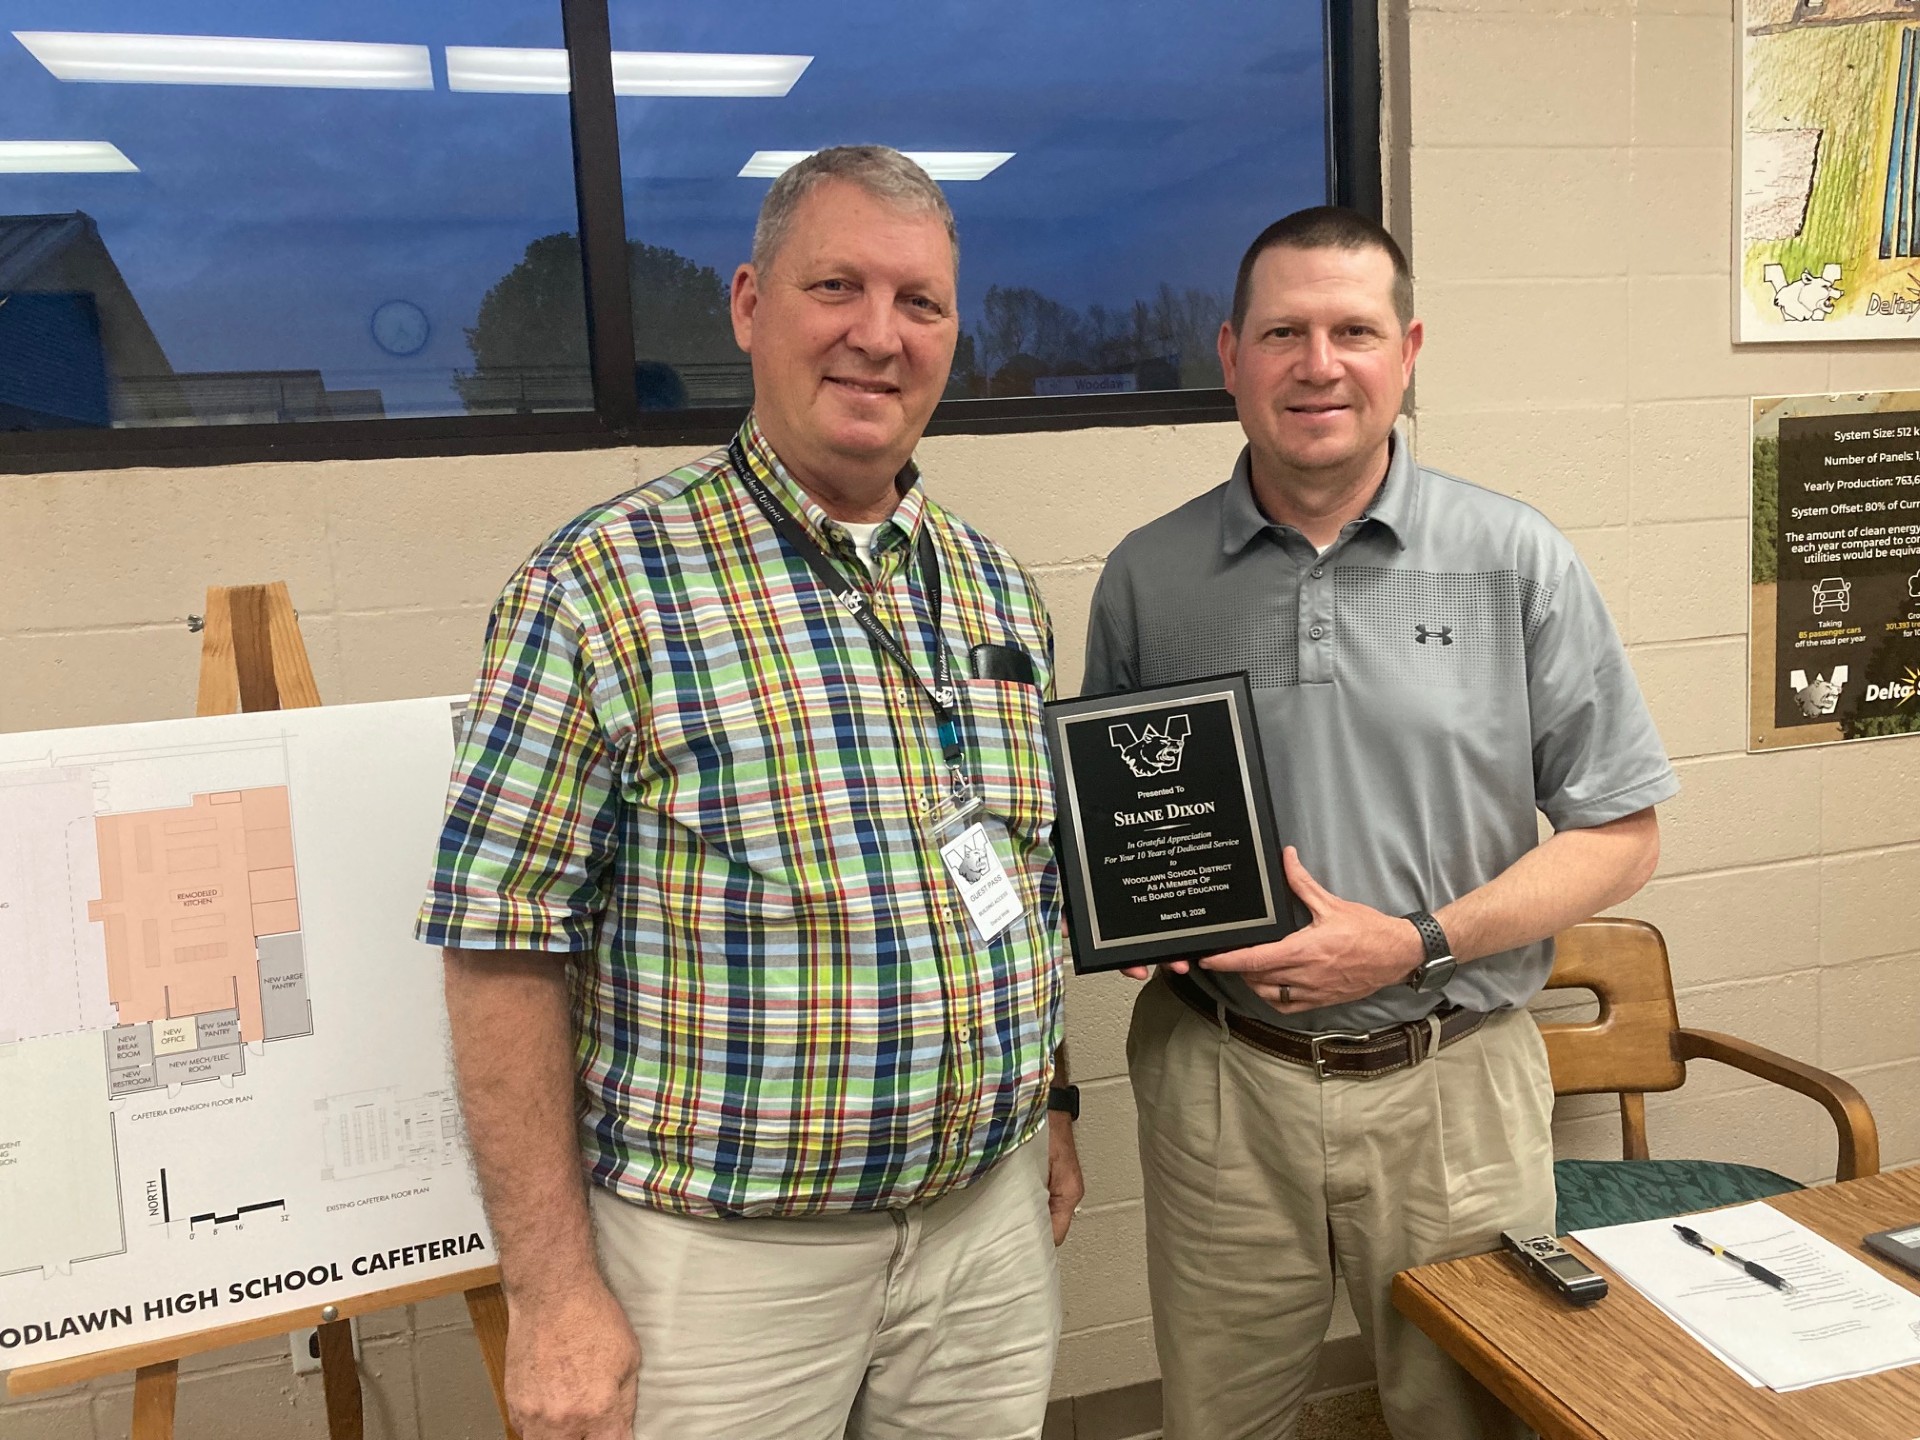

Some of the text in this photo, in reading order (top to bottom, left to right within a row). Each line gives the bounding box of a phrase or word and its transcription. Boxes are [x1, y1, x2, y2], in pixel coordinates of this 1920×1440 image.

[1865, 292, 1914, 316] Delta
[1834, 430, 1871, 443] System
[1873, 428, 1895, 439] Size:
[1897, 427, 1912, 437] 512
[1824, 455, 1866, 466] Number
[1867, 453, 1878, 463] of
[1880, 451, 1913, 462] Panels:
[1804, 481, 1835, 492] Yearly
[1837, 477, 1893, 489] Production:
[1791, 507, 1828, 519] System
[1831, 504, 1863, 514] Offset:
[1865, 501, 1886, 512] 80%
[1887, 500, 1898, 510] of
[1785, 525, 1920, 543] The amount of clean energy
[1791, 543, 1816, 553] each
[1818, 542, 1839, 553] year
[1842, 537, 1891, 549] compared
[1893, 536, 1903, 545] to
[1804, 552, 1841, 564] utilities
[1843, 549, 1873, 560] would
[1875, 548, 1888, 558] be
[1818, 620, 1843, 629] Taking
[1808, 628, 1845, 639] passenger
[1846, 627, 1862, 635] cars
[1795, 635, 1867, 648] off the road per year
[1865, 681, 1910, 702] Delta
[1137, 785, 1185, 799] Presented To
[1114, 801, 1216, 827] SHANE DIXON
[1127, 831, 1212, 850] In Grateful Appreciation
[1104, 839, 1240, 865] For Your 10 Years of Dedicated Service
[1122, 863, 1232, 886] WOODLAWN SCHOOL DISTRICT
[970, 875, 1002, 902] GUEST PASS
[1159, 882, 1166, 890] A
[1166, 878, 1198, 889] MEMBER
[177, 889, 218, 900] REMODELED
[1131, 895, 1148, 904] THE
[1148, 891, 1175, 902] BOARD
[1187, 883, 1230, 895] EDUCATION
[183, 898, 213, 907] KITCHEN
[1160, 911, 1181, 921] March
[1182, 910, 1189, 918] 9,
[264, 973, 304, 984] NEW LARGE
[271, 982, 297, 990] PANTRY
[163, 1028, 182, 1036] NEW
[198, 1020, 238, 1031] NEW SMALL
[204, 1028, 231, 1037] PANTRY
[118, 1035, 137, 1043] NEW
[161, 1035, 186, 1045] OFFICE
[117, 1043, 139, 1051] BREAK
[117, 1050, 141, 1059] ROOM
[169, 1053, 230, 1069] NEW MECH/ELEC
[122, 1070, 141, 1078] NEW
[188, 1065, 212, 1073] ROOM
[113, 1077, 152, 1089] RESTROOM
[131, 1095, 253, 1122] CAFETERIA EXPANSION FLOOR PLAN
[146, 1180, 160, 1217] NORTH
[326, 1187, 430, 1213] EXISTING CAFETERIA FLOOR PLAN
[0, 1232, 486, 1349] ODLAWN HIGH SCHOOL CAFETERIA
